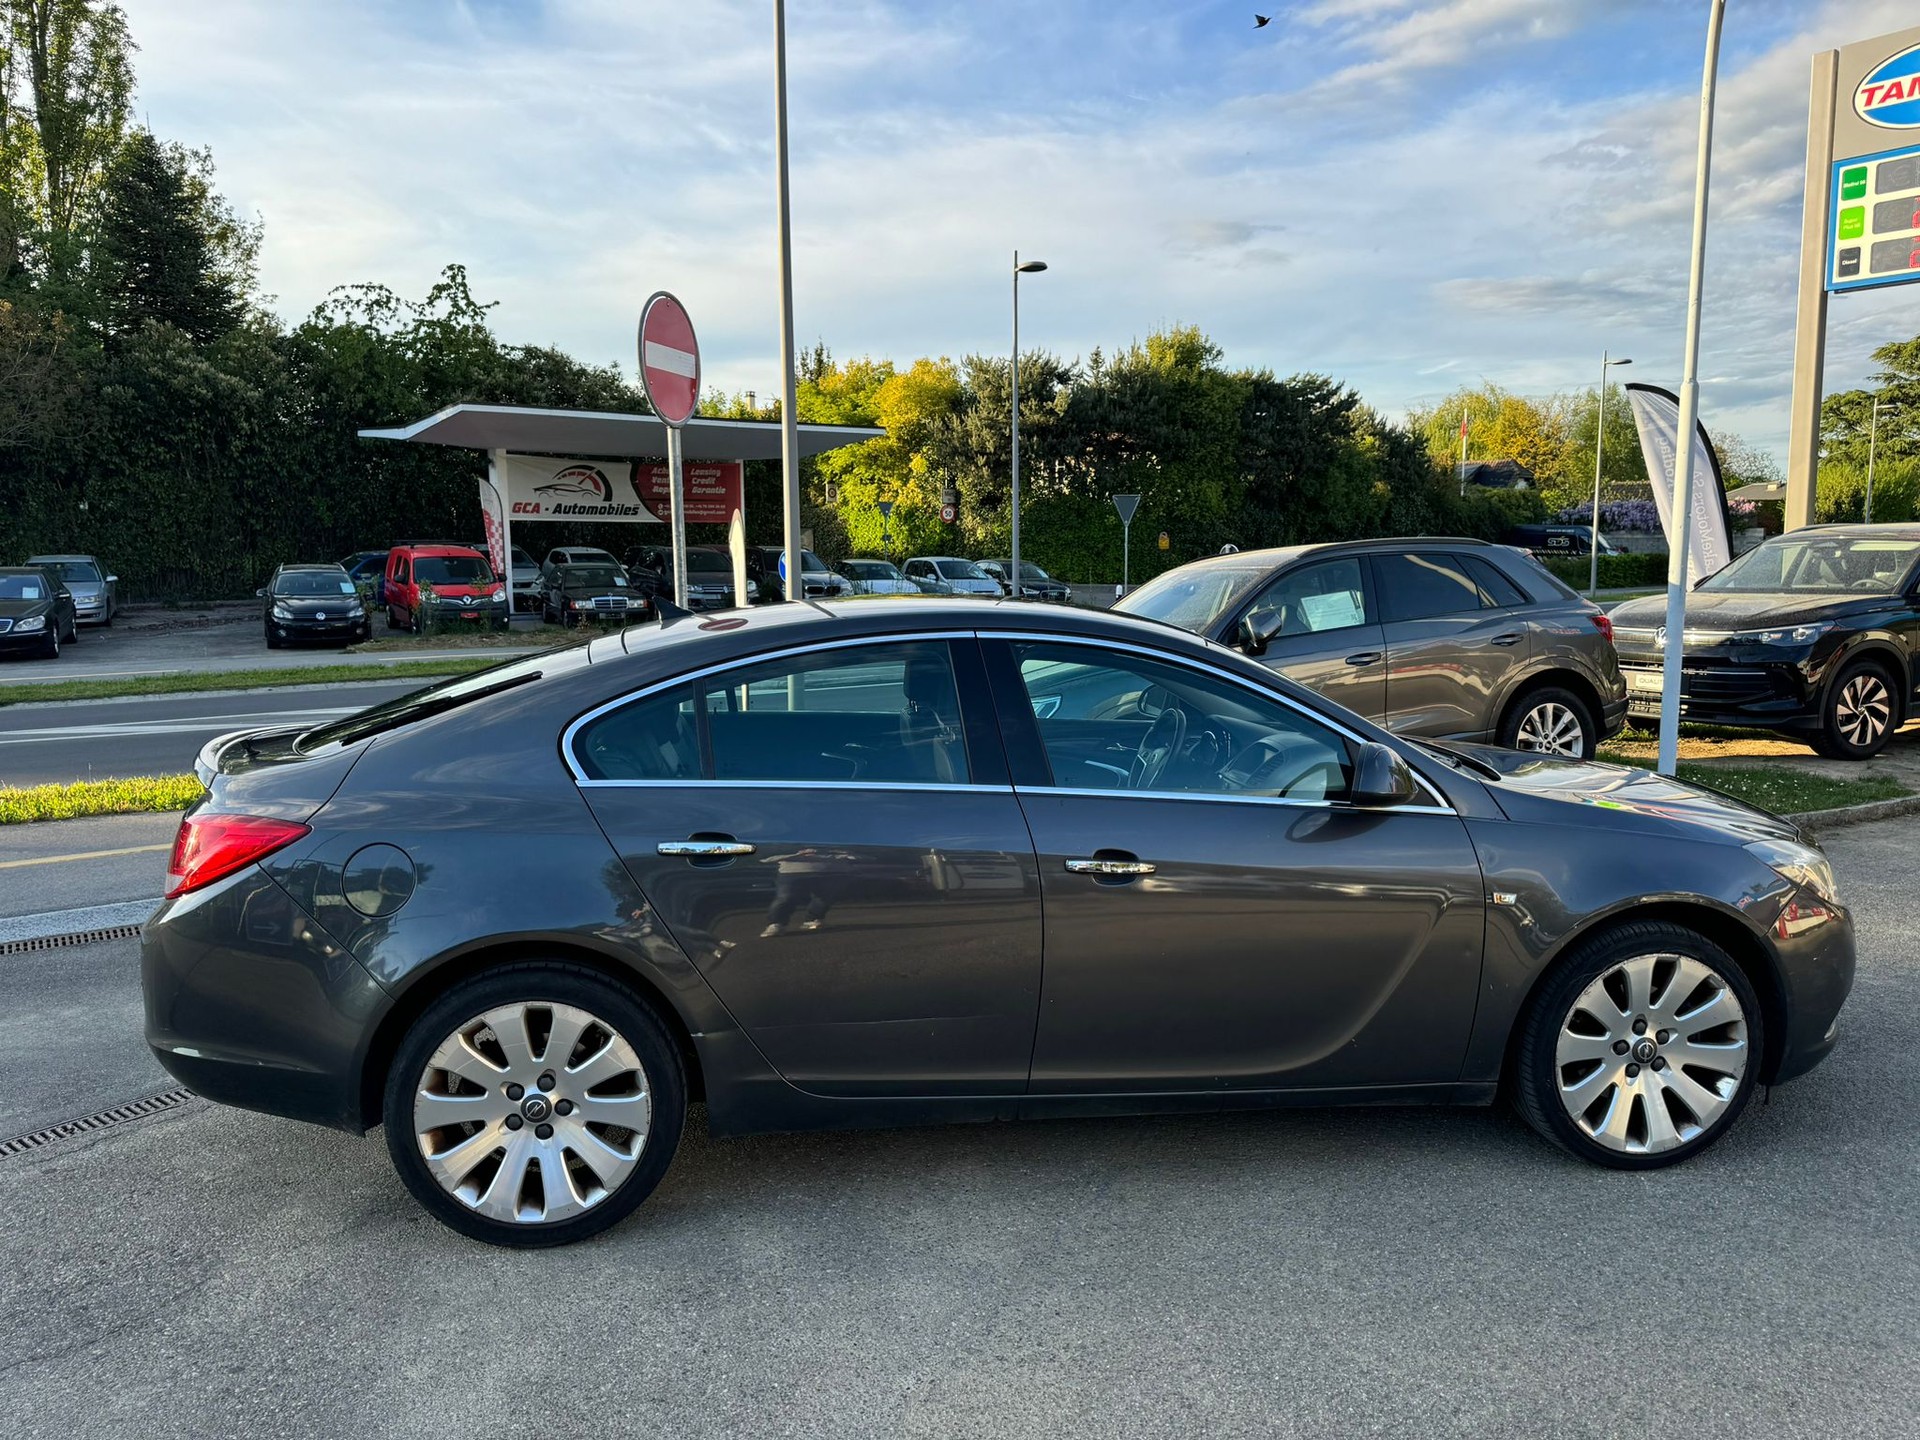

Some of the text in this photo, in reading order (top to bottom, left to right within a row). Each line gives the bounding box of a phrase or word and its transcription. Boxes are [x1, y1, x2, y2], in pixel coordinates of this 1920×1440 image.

[1842, 258, 1858, 266] Diesel
[690, 467, 721, 478] Leasing
[691, 485, 727, 494] Garantie
[512, 502, 541, 514] GCA
[552, 503, 639, 516] Automobiles
[944, 510, 952, 518] 50
[1638, 677, 1663, 686] QUALIT
